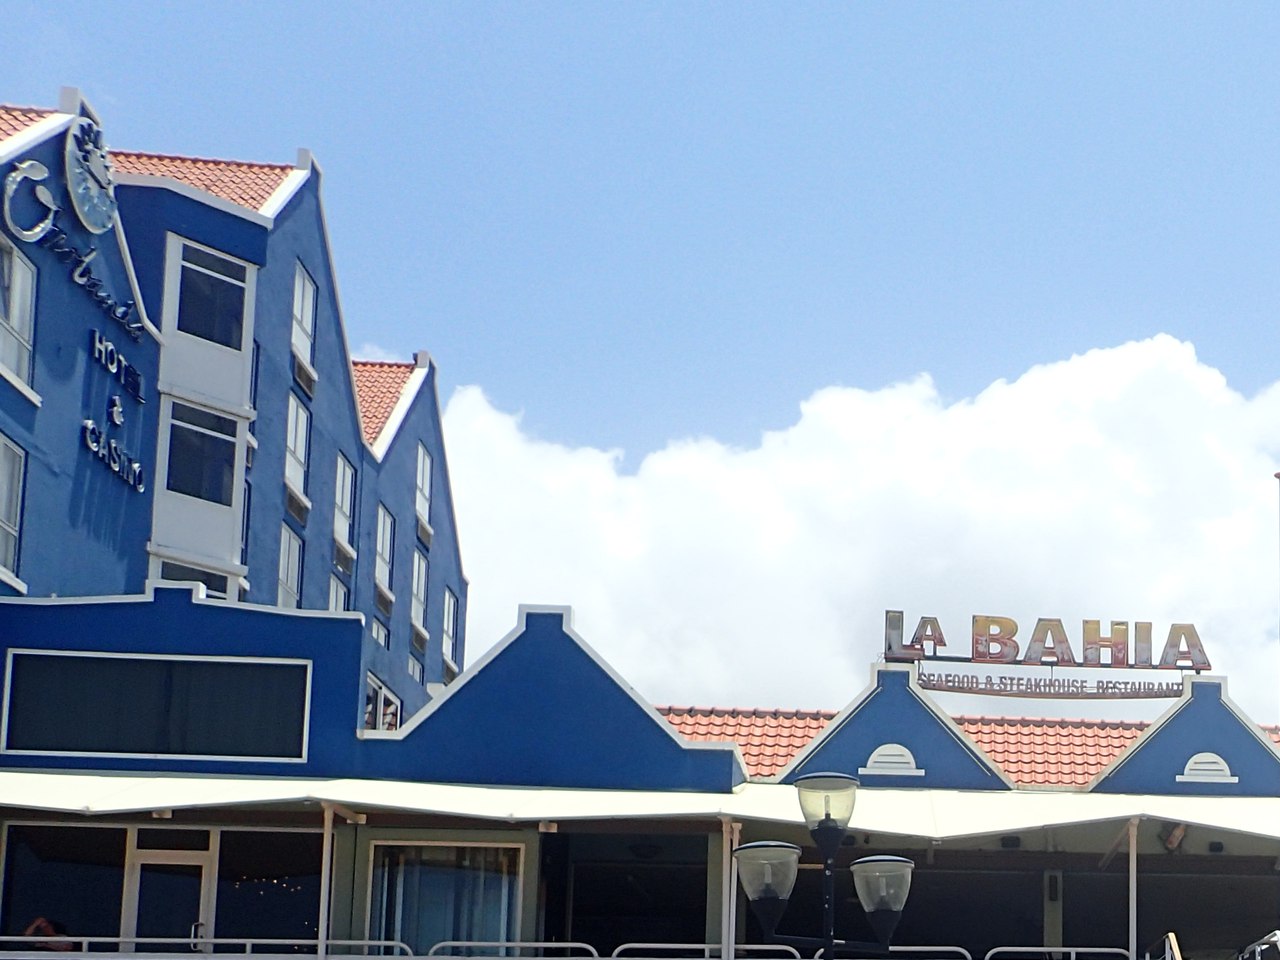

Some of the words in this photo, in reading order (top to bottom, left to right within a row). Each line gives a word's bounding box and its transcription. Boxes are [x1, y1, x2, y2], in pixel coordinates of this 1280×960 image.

[93, 328, 146, 404] HOTEL
[82, 419, 145, 494] CASINO
[885, 609, 947, 660] LA
[971, 614, 1212, 671] BAHIA
[918, 672, 979, 690] SEAFOOD
[985, 675, 995, 691] &
[998, 675, 1088, 694] STEAKHOUSE
[1096, 679, 1183, 695] RESTAURANT
